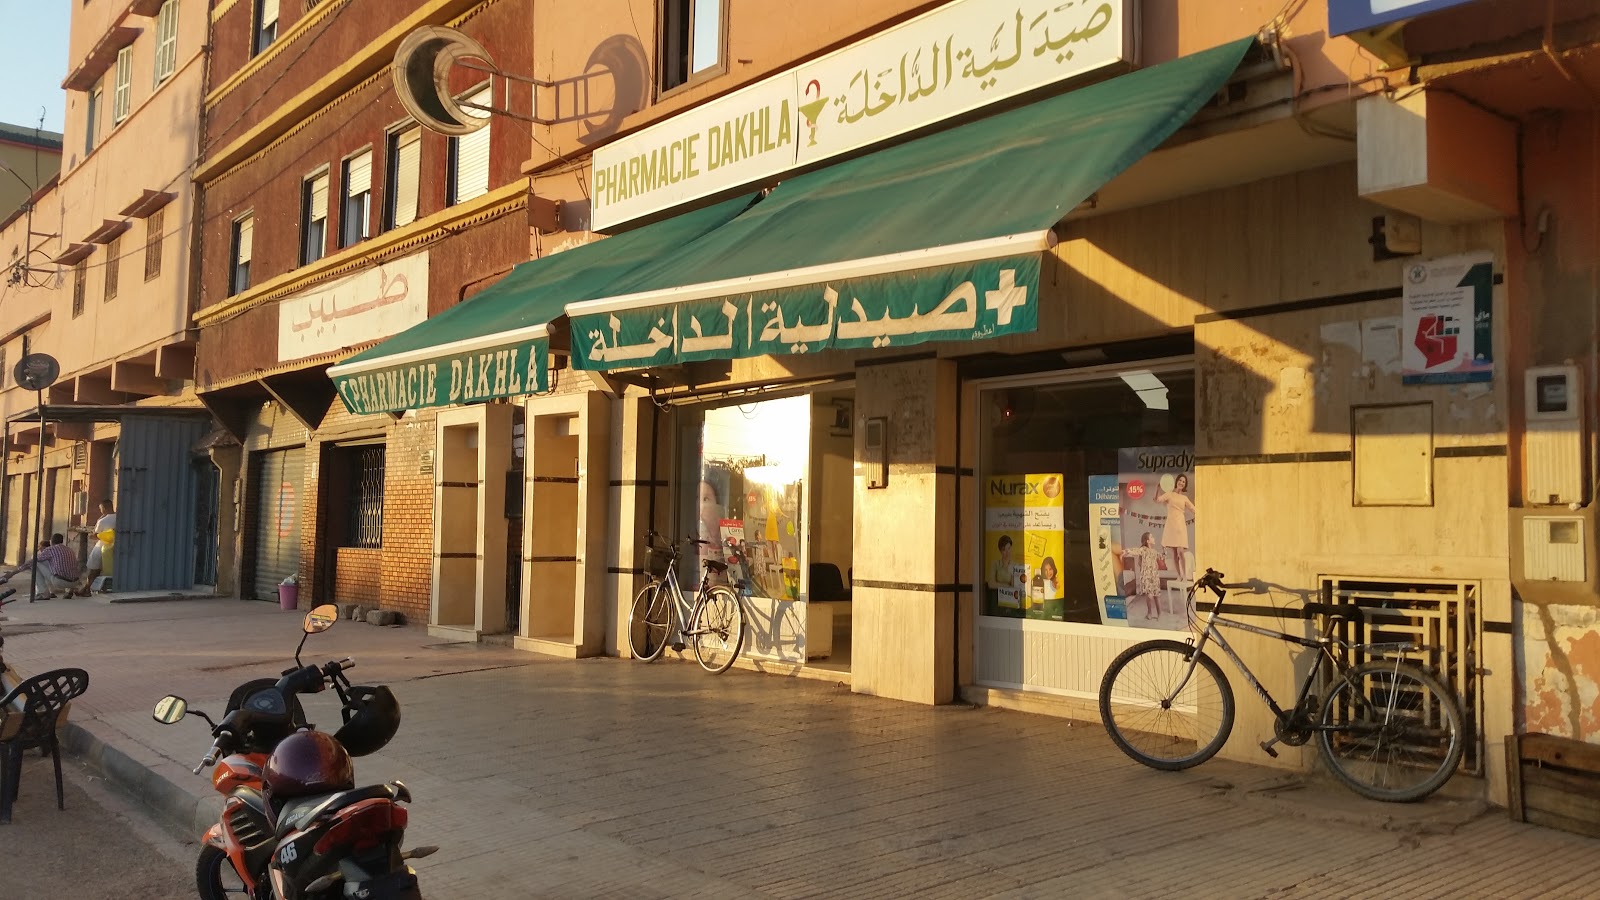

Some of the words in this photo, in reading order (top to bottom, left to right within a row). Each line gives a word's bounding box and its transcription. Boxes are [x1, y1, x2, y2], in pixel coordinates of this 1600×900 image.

[595, 133, 700, 209] PHARMACIE
[707, 98, 792, 172] DAKHLA
[291, 267, 409, 342] طبيب
[588, 294, 754, 362] الداخلة
[760, 281, 977, 354] صيدلية
[349, 363, 437, 413] PHARMACIE
[449, 345, 539, 401] DAKHLA
[990, 479, 1040, 497] Nurax
[1138, 450, 1195, 472] Suprady
[281, 841, 298, 864] 46
